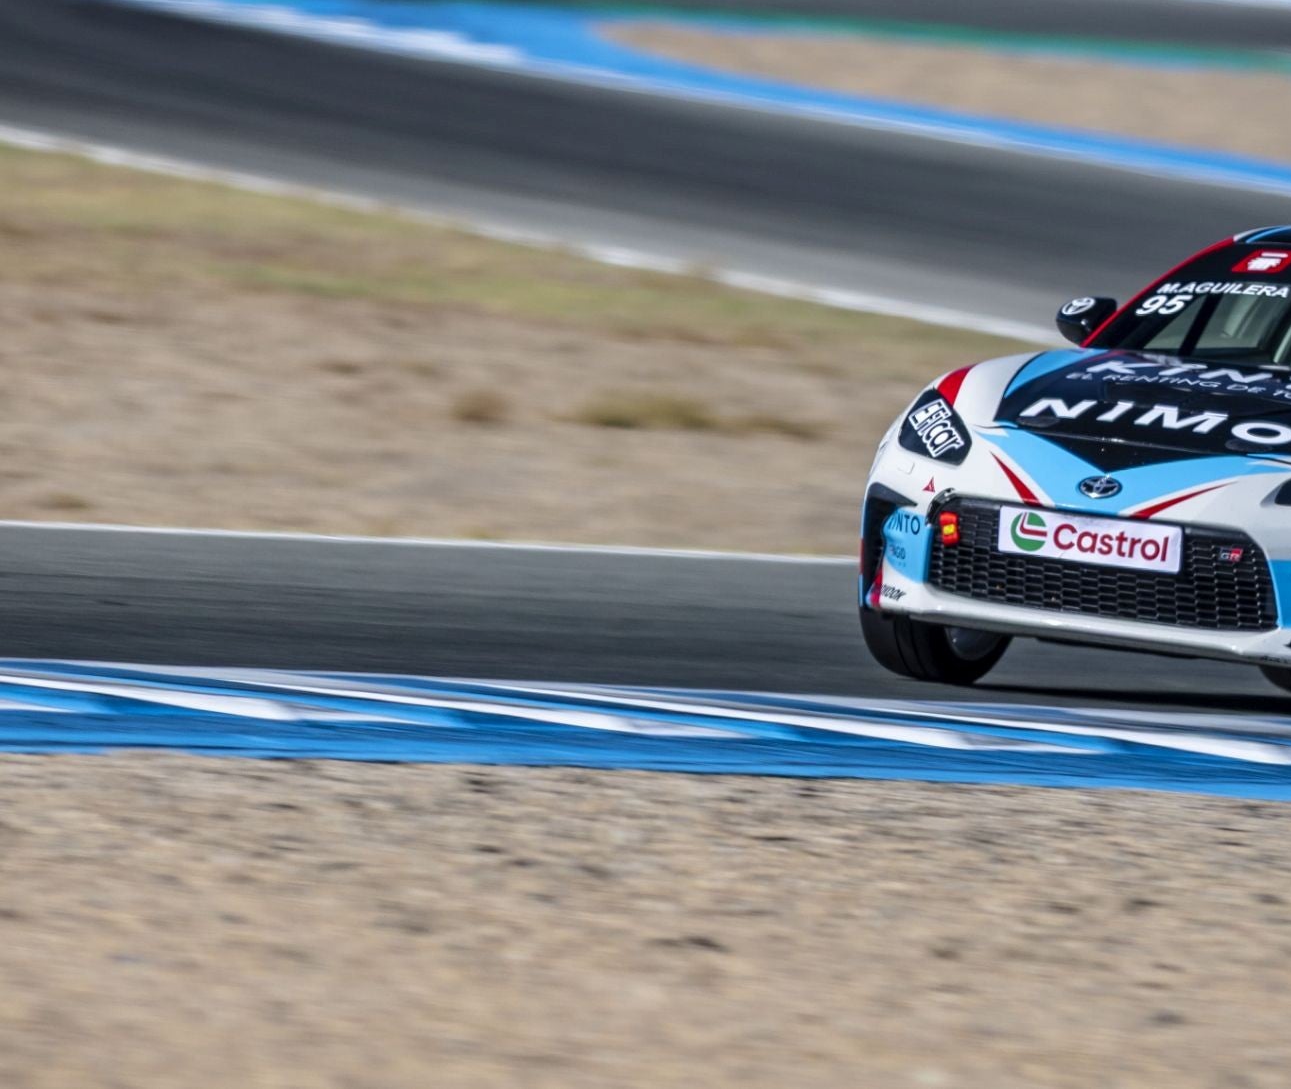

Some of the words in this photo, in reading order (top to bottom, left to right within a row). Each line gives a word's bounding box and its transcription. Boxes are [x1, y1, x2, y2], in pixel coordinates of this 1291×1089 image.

[1156, 281, 1290, 298] M.AGUILERA
[1135, 295, 1194, 315] 95
[1102, 373, 1221, 388] RENTING
[1227, 384, 1266, 394] DE
[1053, 523, 1170, 562] Castrol
